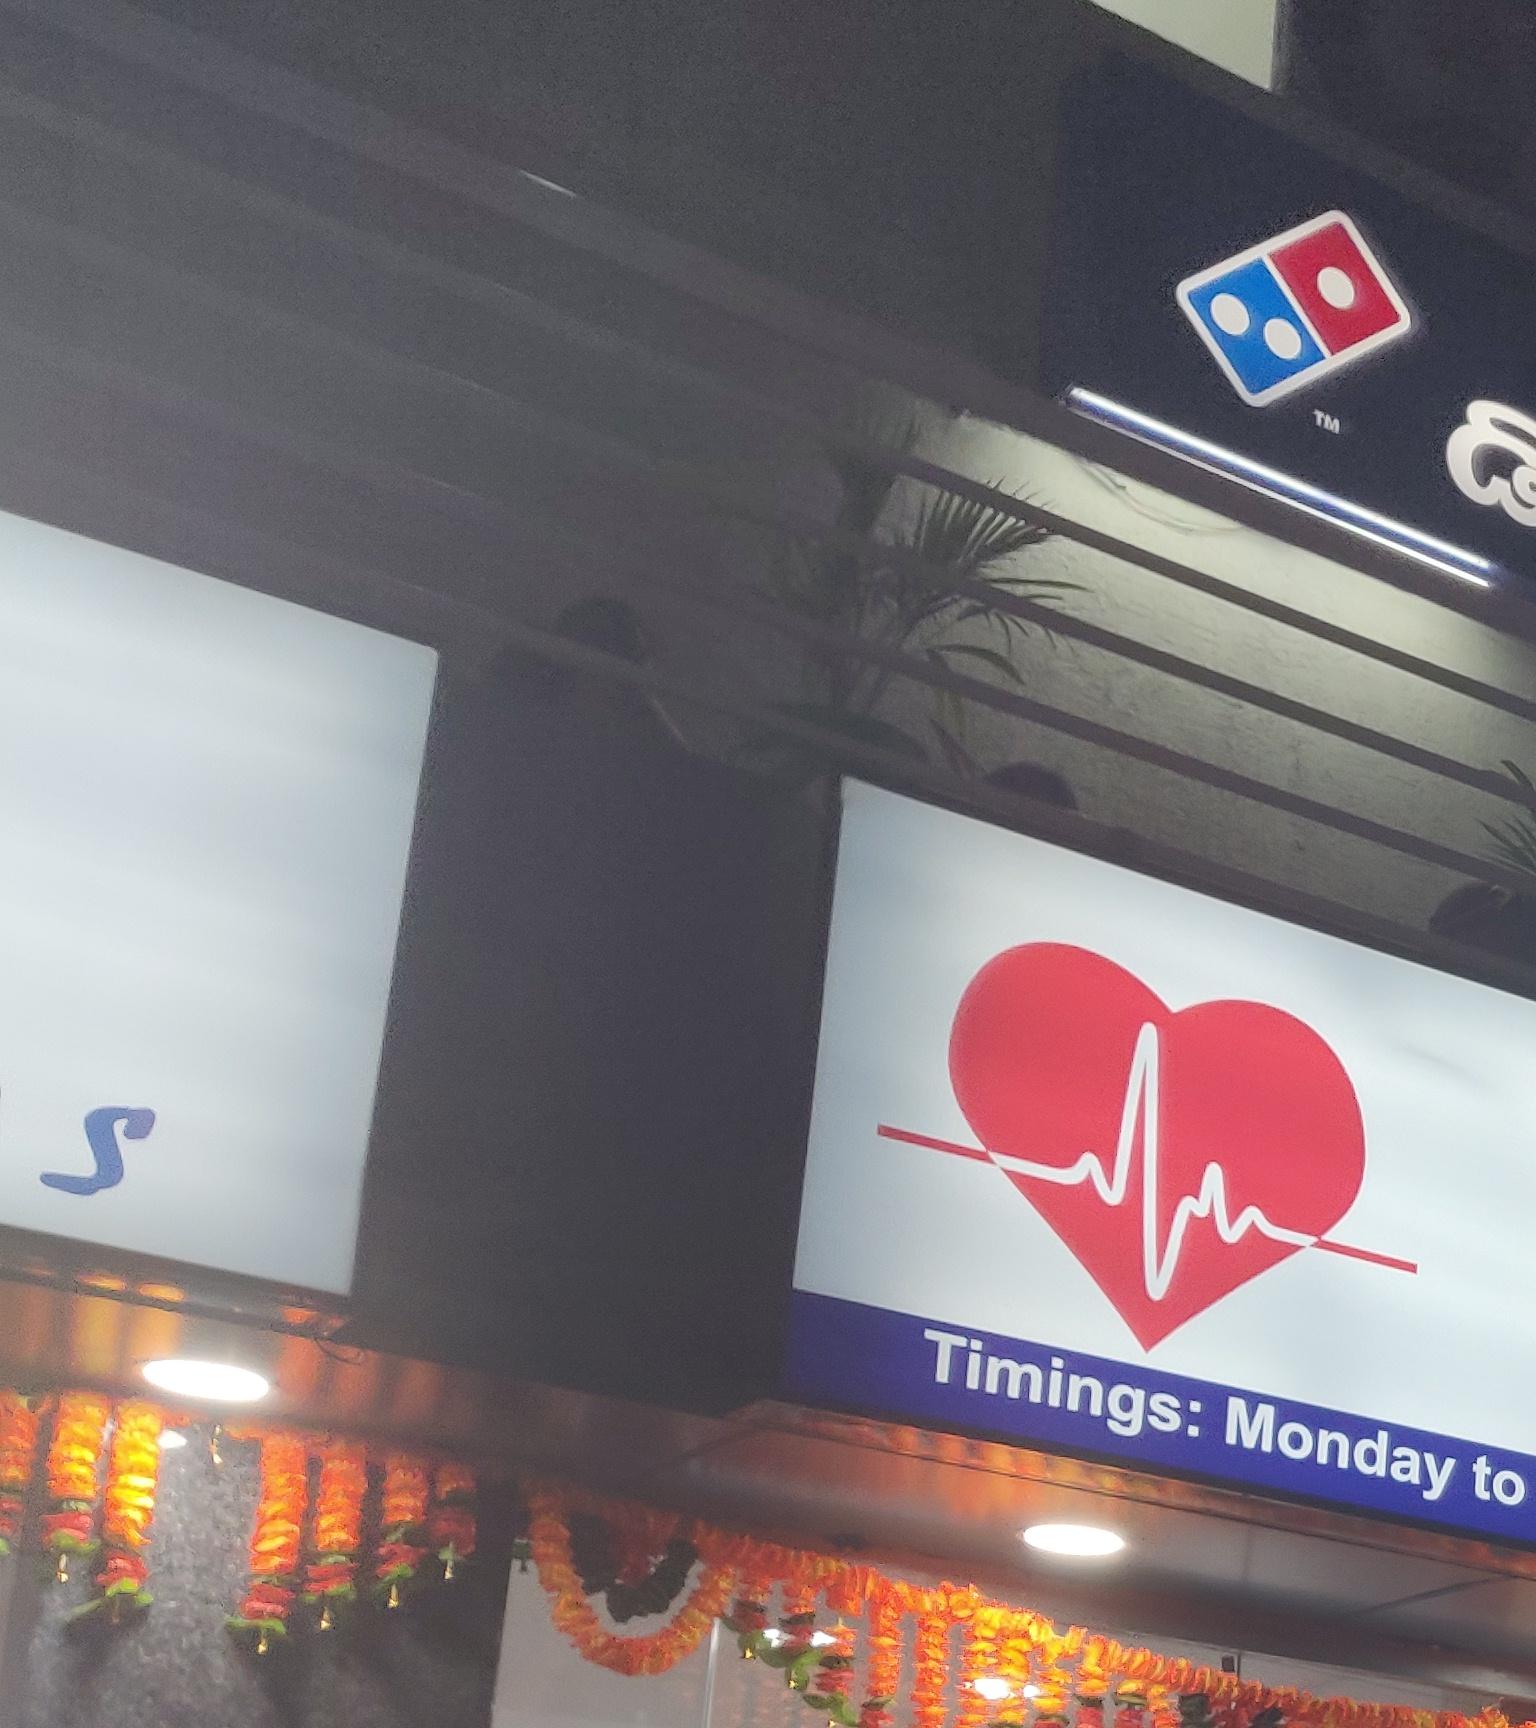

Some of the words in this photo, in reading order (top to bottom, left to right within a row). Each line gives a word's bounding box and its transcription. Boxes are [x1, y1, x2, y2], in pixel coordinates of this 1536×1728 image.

[923, 1327, 1201, 1438] Timings:
[1224, 1395, 1457, 1501] Monday
[1471, 1454, 1526, 1508] to
